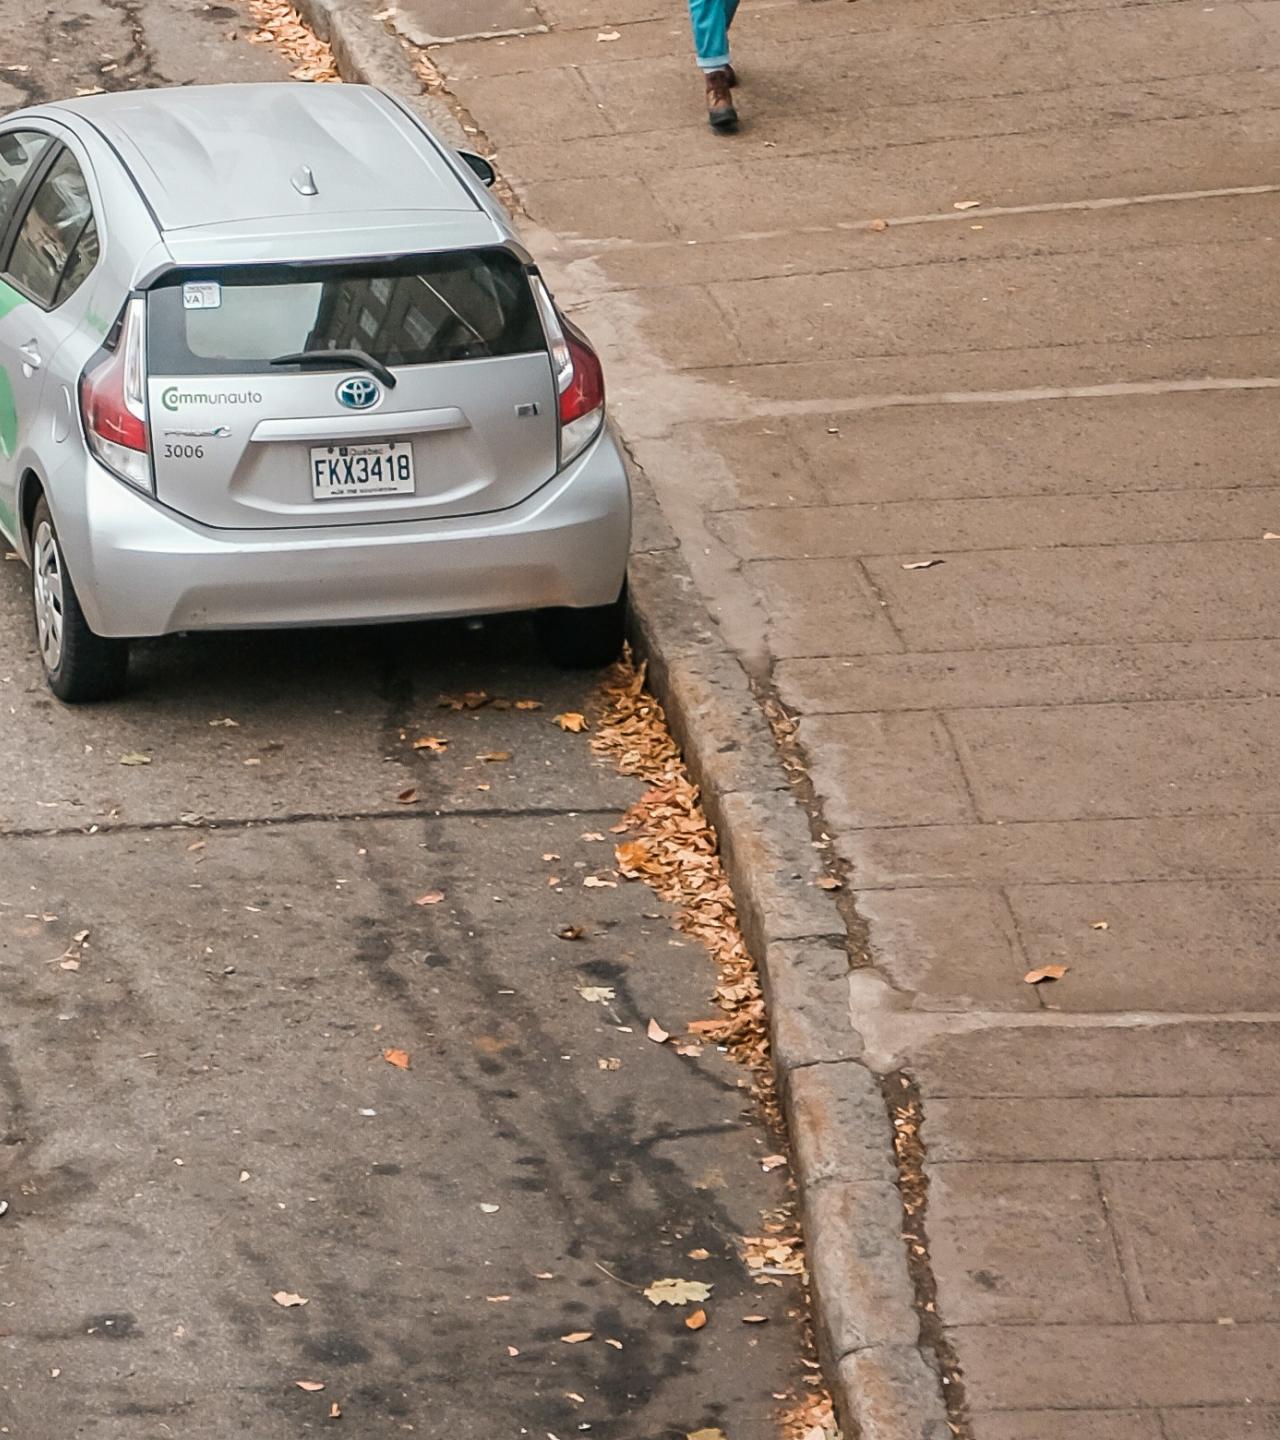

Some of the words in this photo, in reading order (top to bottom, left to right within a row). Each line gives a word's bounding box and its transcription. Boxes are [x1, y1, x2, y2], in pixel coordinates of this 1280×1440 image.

[161, 385, 263, 412] Communauto
[163, 443, 204, 459] 3006
[314, 454, 411, 487] FKX3418
